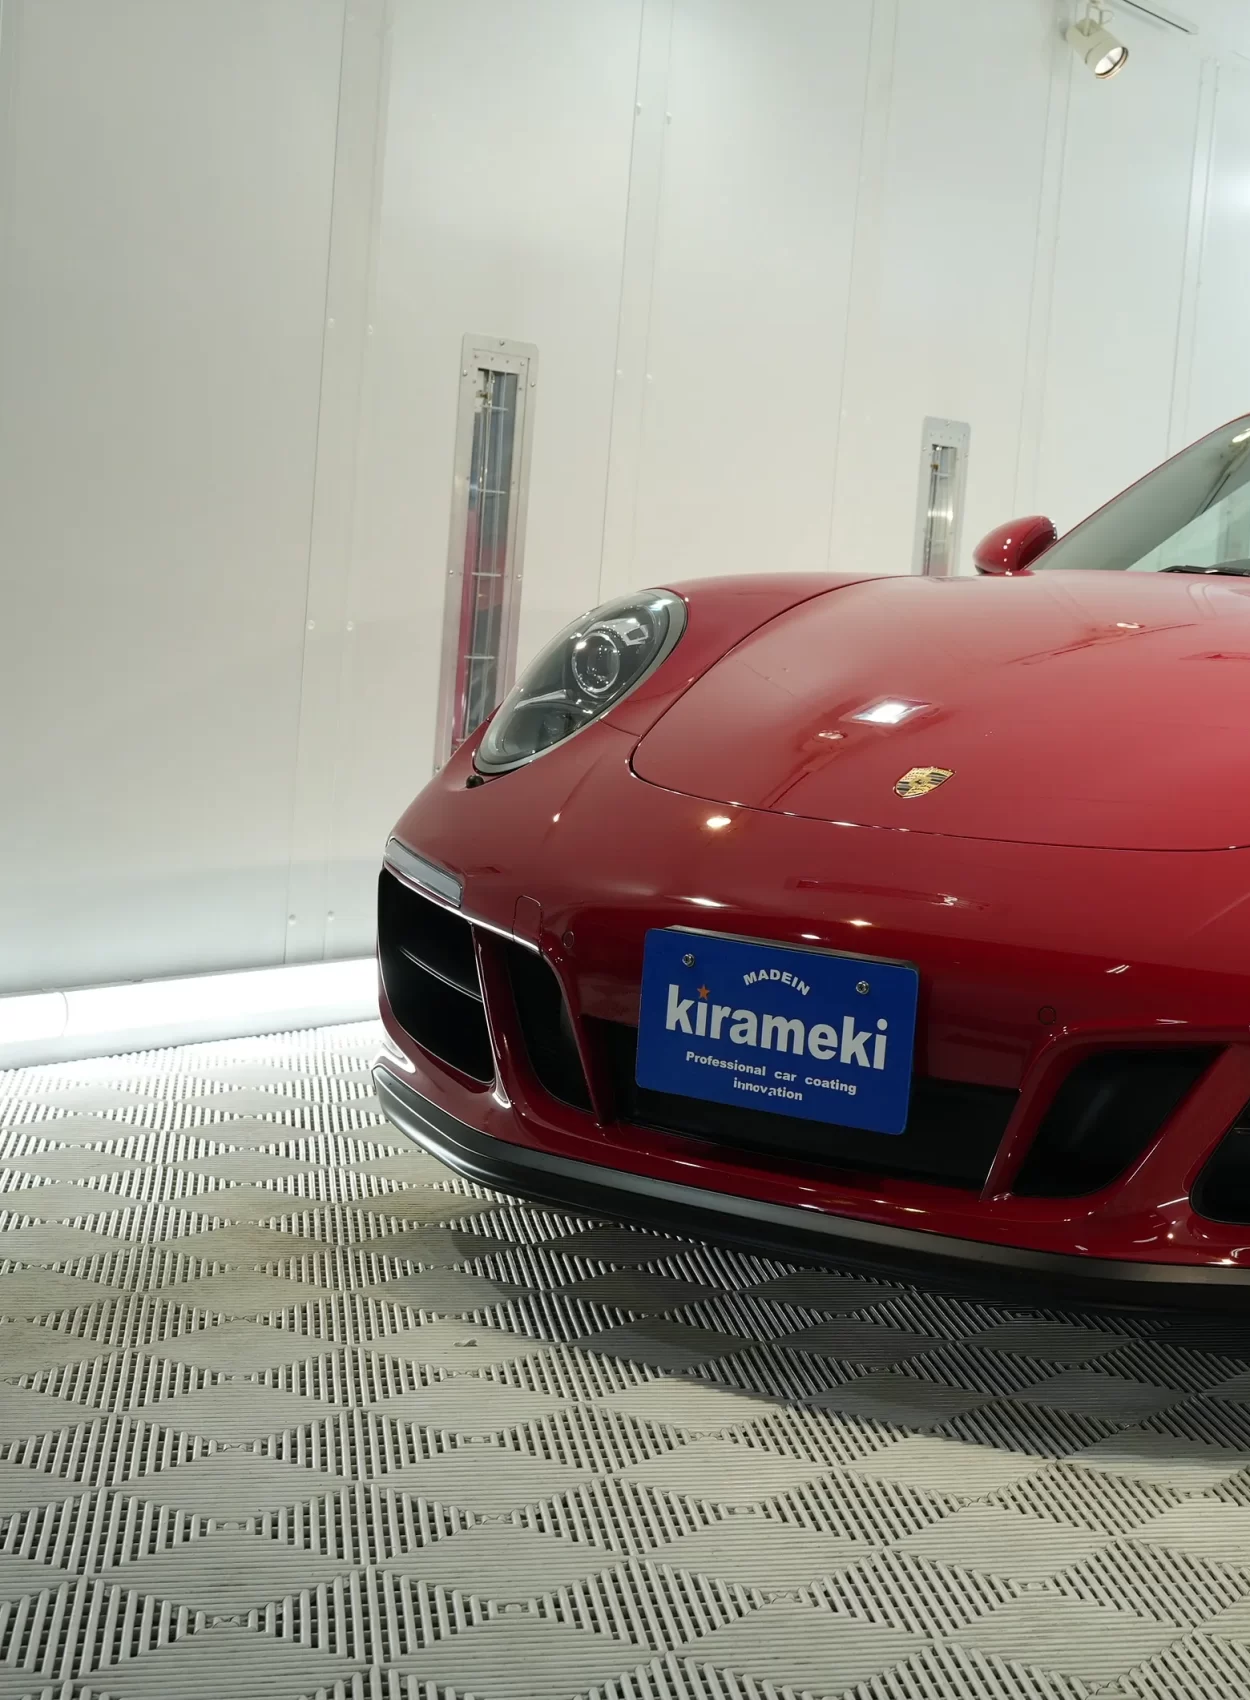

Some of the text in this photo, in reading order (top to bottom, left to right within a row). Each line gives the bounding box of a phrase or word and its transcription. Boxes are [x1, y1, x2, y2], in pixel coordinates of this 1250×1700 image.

[665, 983, 888, 1071] kirameki
[685, 1051, 857, 1096] Professional car coating
[733, 1077, 803, 1101] innovation
